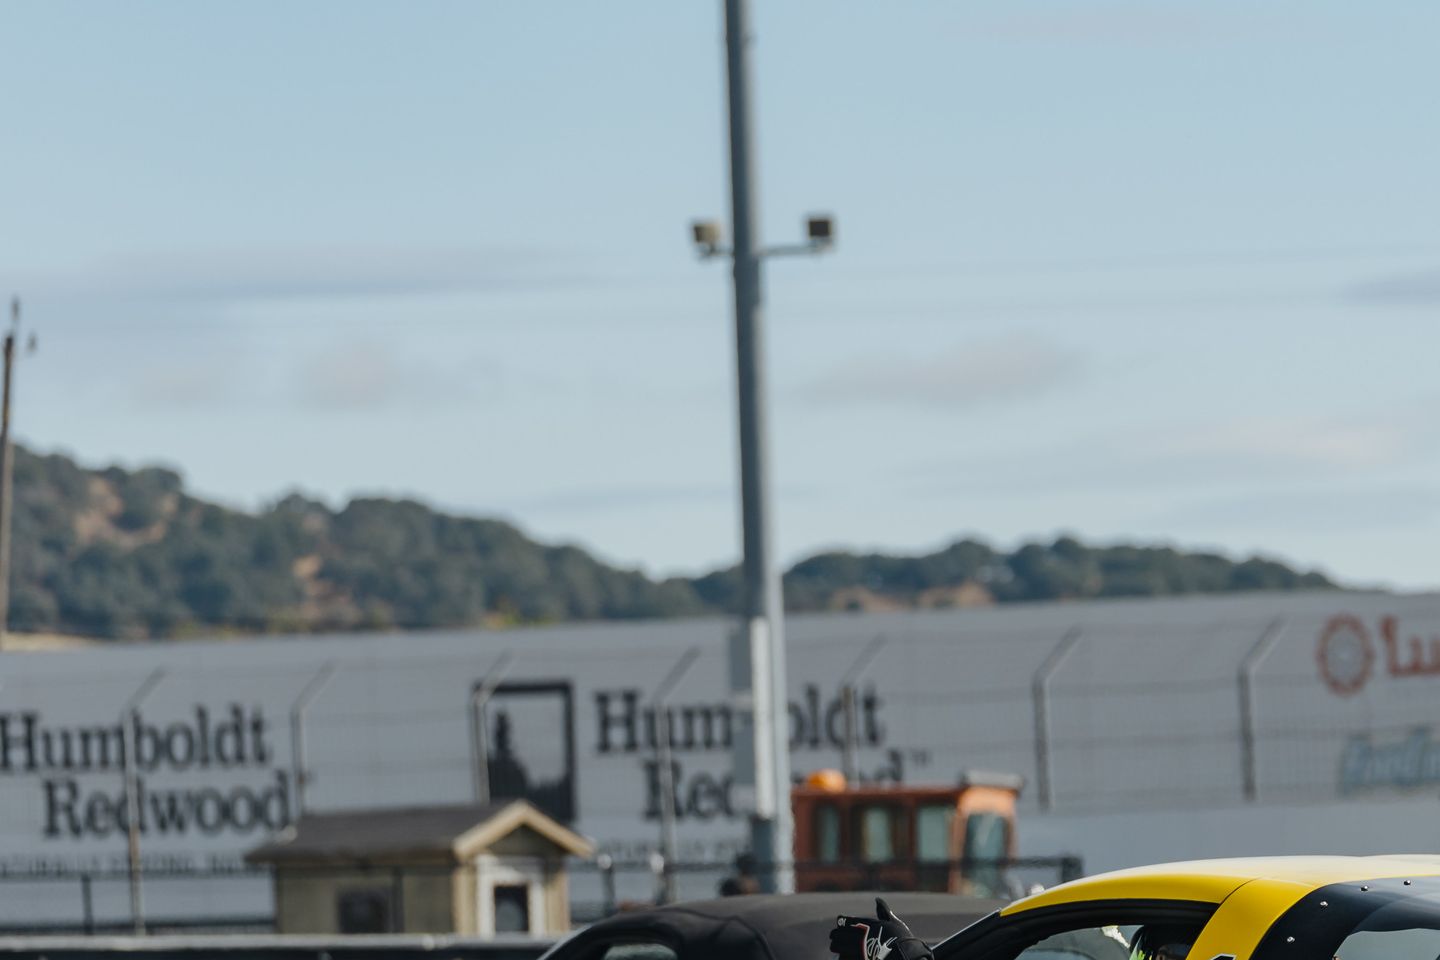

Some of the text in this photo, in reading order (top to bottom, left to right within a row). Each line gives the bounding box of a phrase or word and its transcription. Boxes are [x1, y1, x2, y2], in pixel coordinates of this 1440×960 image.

[0, 702, 270, 770] Humboldt
[595, 684, 885, 751] Humldt
[43, 769, 291, 839] Redwood
